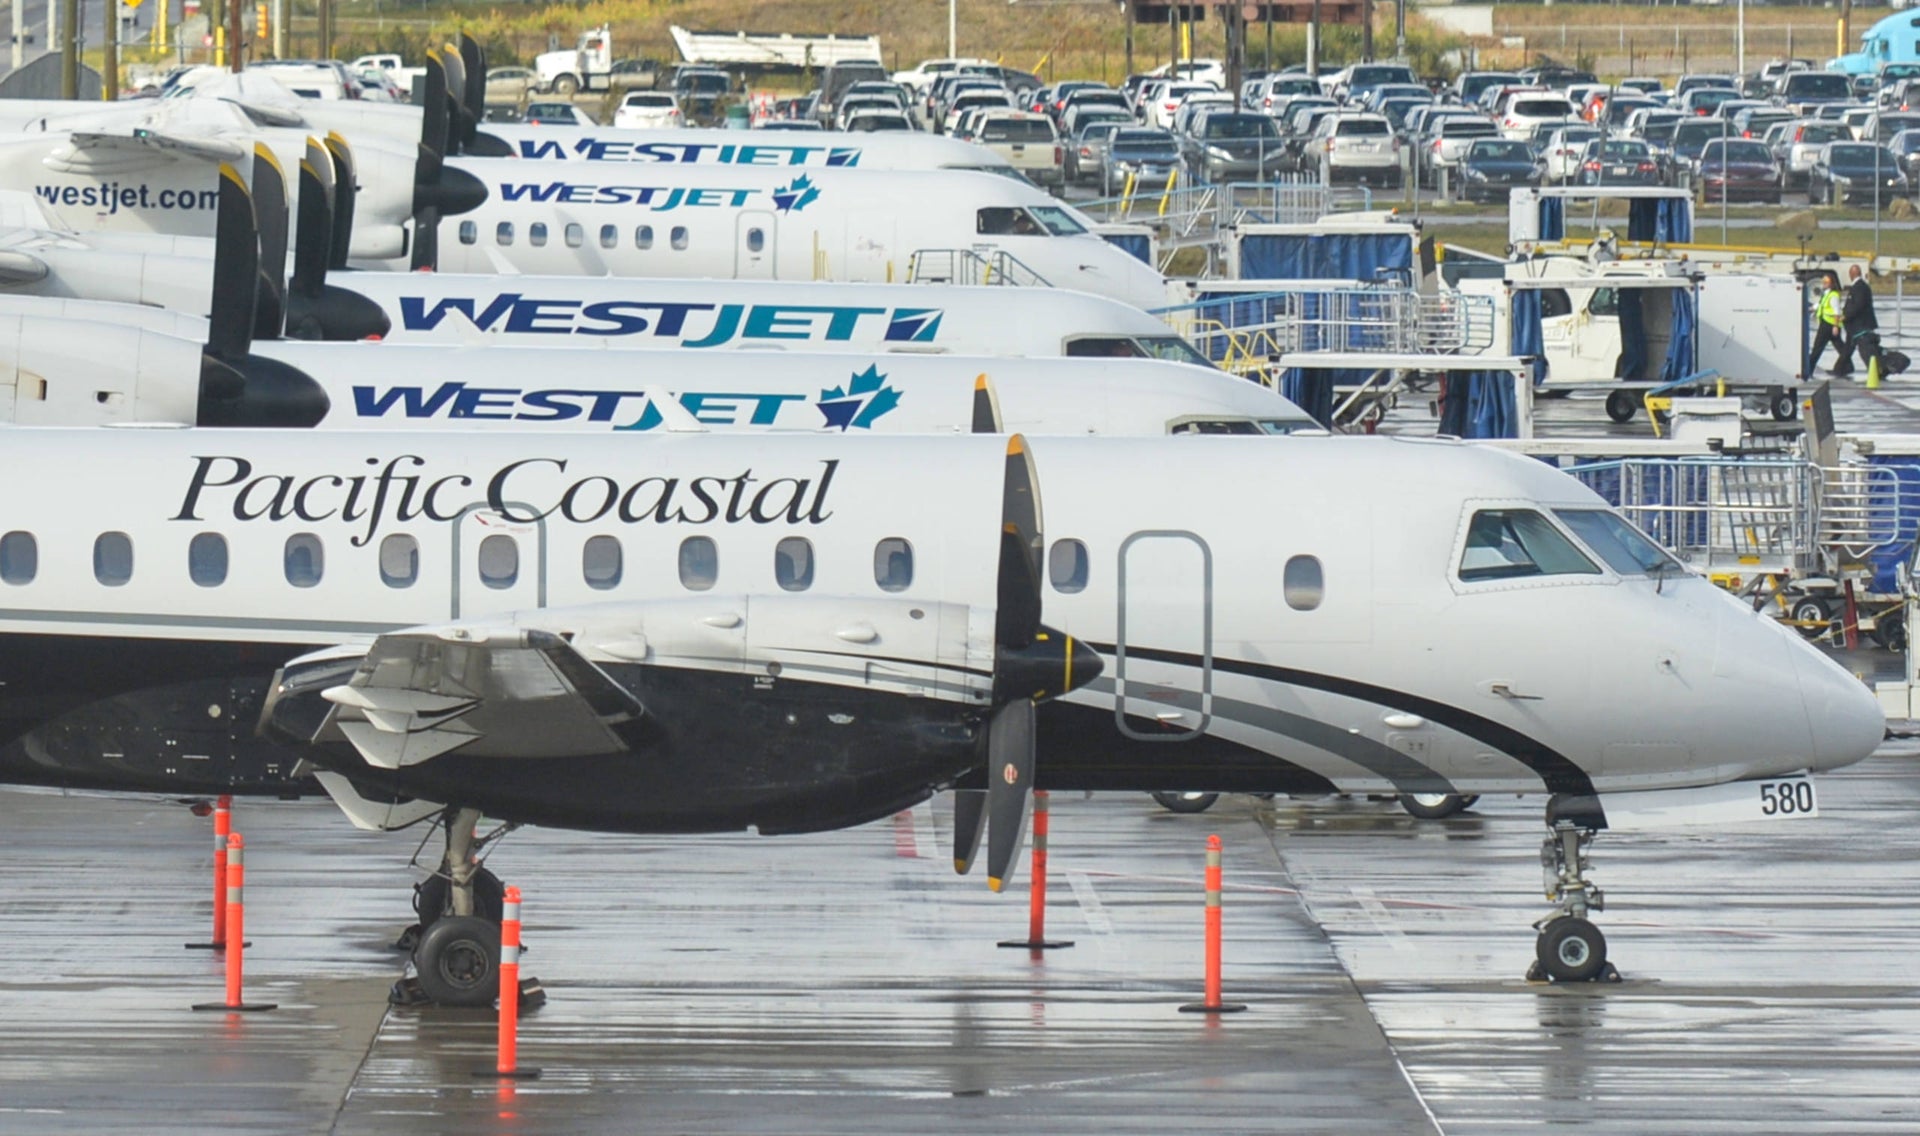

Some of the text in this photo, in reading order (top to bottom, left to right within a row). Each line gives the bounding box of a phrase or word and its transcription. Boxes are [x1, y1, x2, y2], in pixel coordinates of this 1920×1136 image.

[519, 138, 826, 165] WESTJET
[36, 182, 219, 215] westjet.com
[500, 182, 762, 212] WESTJET
[399, 293, 888, 348] WESTJET
[351, 382, 807, 431] WESTJET
[168, 455, 840, 547] Pacific Coastal
[1760, 781, 1813, 815] 580
